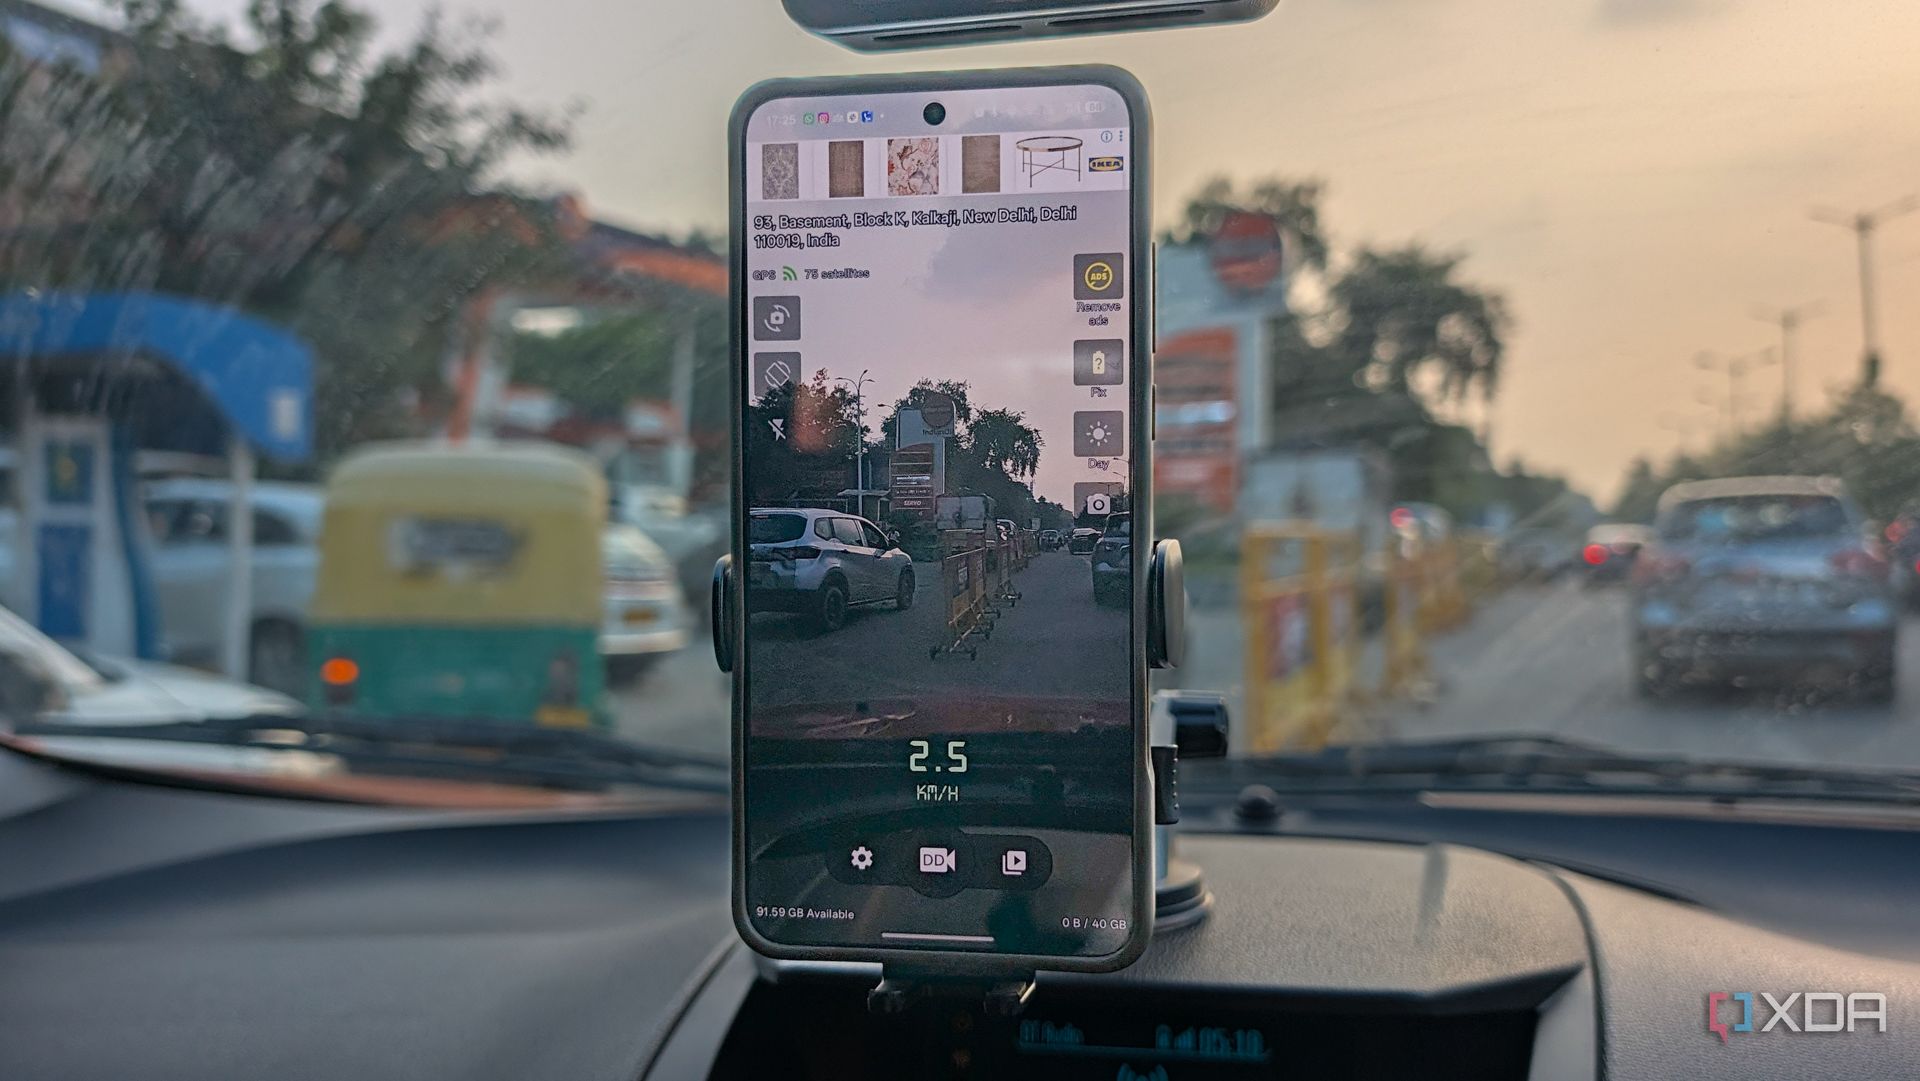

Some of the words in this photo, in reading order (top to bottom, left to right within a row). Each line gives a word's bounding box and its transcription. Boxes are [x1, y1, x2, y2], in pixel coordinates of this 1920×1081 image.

[1091, 160, 1121, 168] IKEA
[754, 214, 776, 231] 93,
[779, 213, 851, 229] Basement,
[853, 211, 893, 227] Block
[894, 211, 909, 228] K,
[912, 209, 961, 227] Kalkaji,
[963, 209, 996, 224] New
[998, 207, 1037, 223] Delhi,
[1040, 205, 1077, 222] Delhi
[754, 233, 804, 250] 110019,
[806, 232, 840, 248] India
[752, 269, 776, 281] GPS
[804, 268, 819, 280] 75
[821, 267, 870, 279] satellites
[1090, 272, 1107, 281] ADS
[1076, 301, 1121, 313] Remove
[1088, 314, 1109, 326] ads
[1090, 386, 1107, 398] Fix
[1087, 457, 1110, 471] Day
[909, 740, 967, 773] 2.5
[916, 784, 959, 802] KM/H
[923, 853, 945, 866] DD
[756, 906, 786, 917] 91.59
[788, 907, 804, 918] GB
[806, 908, 855, 919] Available
[1062, 917, 1070, 928] 0
[1073, 917, 1081, 928] B
[1083, 917, 1089, 929] /
[1092, 918, 1107, 929] 40
[1110, 919, 1127, 930] GB
